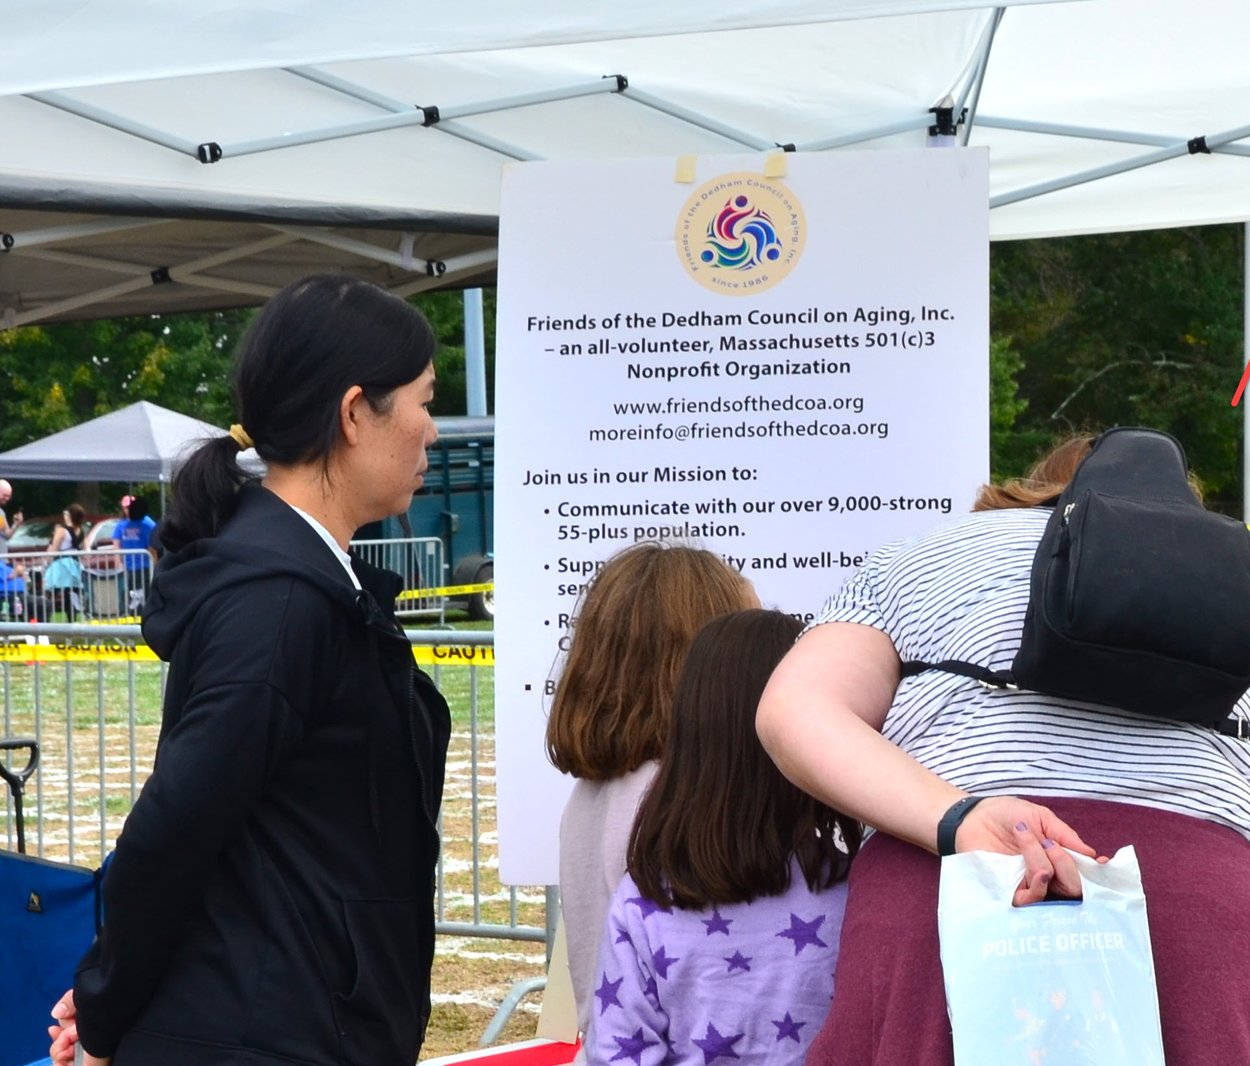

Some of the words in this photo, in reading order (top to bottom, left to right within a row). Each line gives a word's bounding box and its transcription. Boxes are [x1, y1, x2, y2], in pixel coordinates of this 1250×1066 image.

[701, 181, 742, 200] Dedham
[747, 179, 784, 199] Council
[688, 202, 700, 216] the
[784, 200, 792, 210] on
[684, 220, 690, 230] of
[682, 234, 698, 272] Friends
[712, 277, 739, 288] since
[527, 315, 596, 333] Friends
[602, 313, 621, 330] of
[625, 313, 656, 328] the
[661, 310, 742, 329] Dedham
[747, 308, 818, 326] Council
[824, 308, 848, 323] on
[853, 306, 916, 325] Aging,
[921, 306, 954, 322] Inc.
[559, 340, 582, 356] an
[587, 336, 715, 355] all-volunteer,
[719, 332, 859, 351] Massachusetts
[864, 329, 935, 349] 501(c)3
[627, 361, 720, 383] Nonprofit
[725, 359, 851, 379] Organization
[613, 395, 864, 416] www.friendsofthedcoa.org
[588, 420, 889, 442] moreinfo@friendsofthedcoa.org
[523, 468, 561, 486] Join
[567, 471, 588, 485] us
[594, 468, 610, 484] in
[615, 467, 648, 484] our
[654, 465, 726, 482] Mission
[731, 465, 757, 481] to:
[557, 500, 690, 518] Communicate
[695, 497, 737, 515] with
[742, 498, 776, 514] our
[780, 498, 822, 513] over
[828, 495, 952, 515] 9,000-strong
[557, 522, 628, 541] 55-plus
[633, 521, 746, 542] population.
[557, 557, 607, 575] Supp
[751, 554, 787, 569] and
[793, 551, 869, 569] well-bei
[982, 935, 1051, 960] POLICE
[1056, 933, 1124, 952] OFFICER
